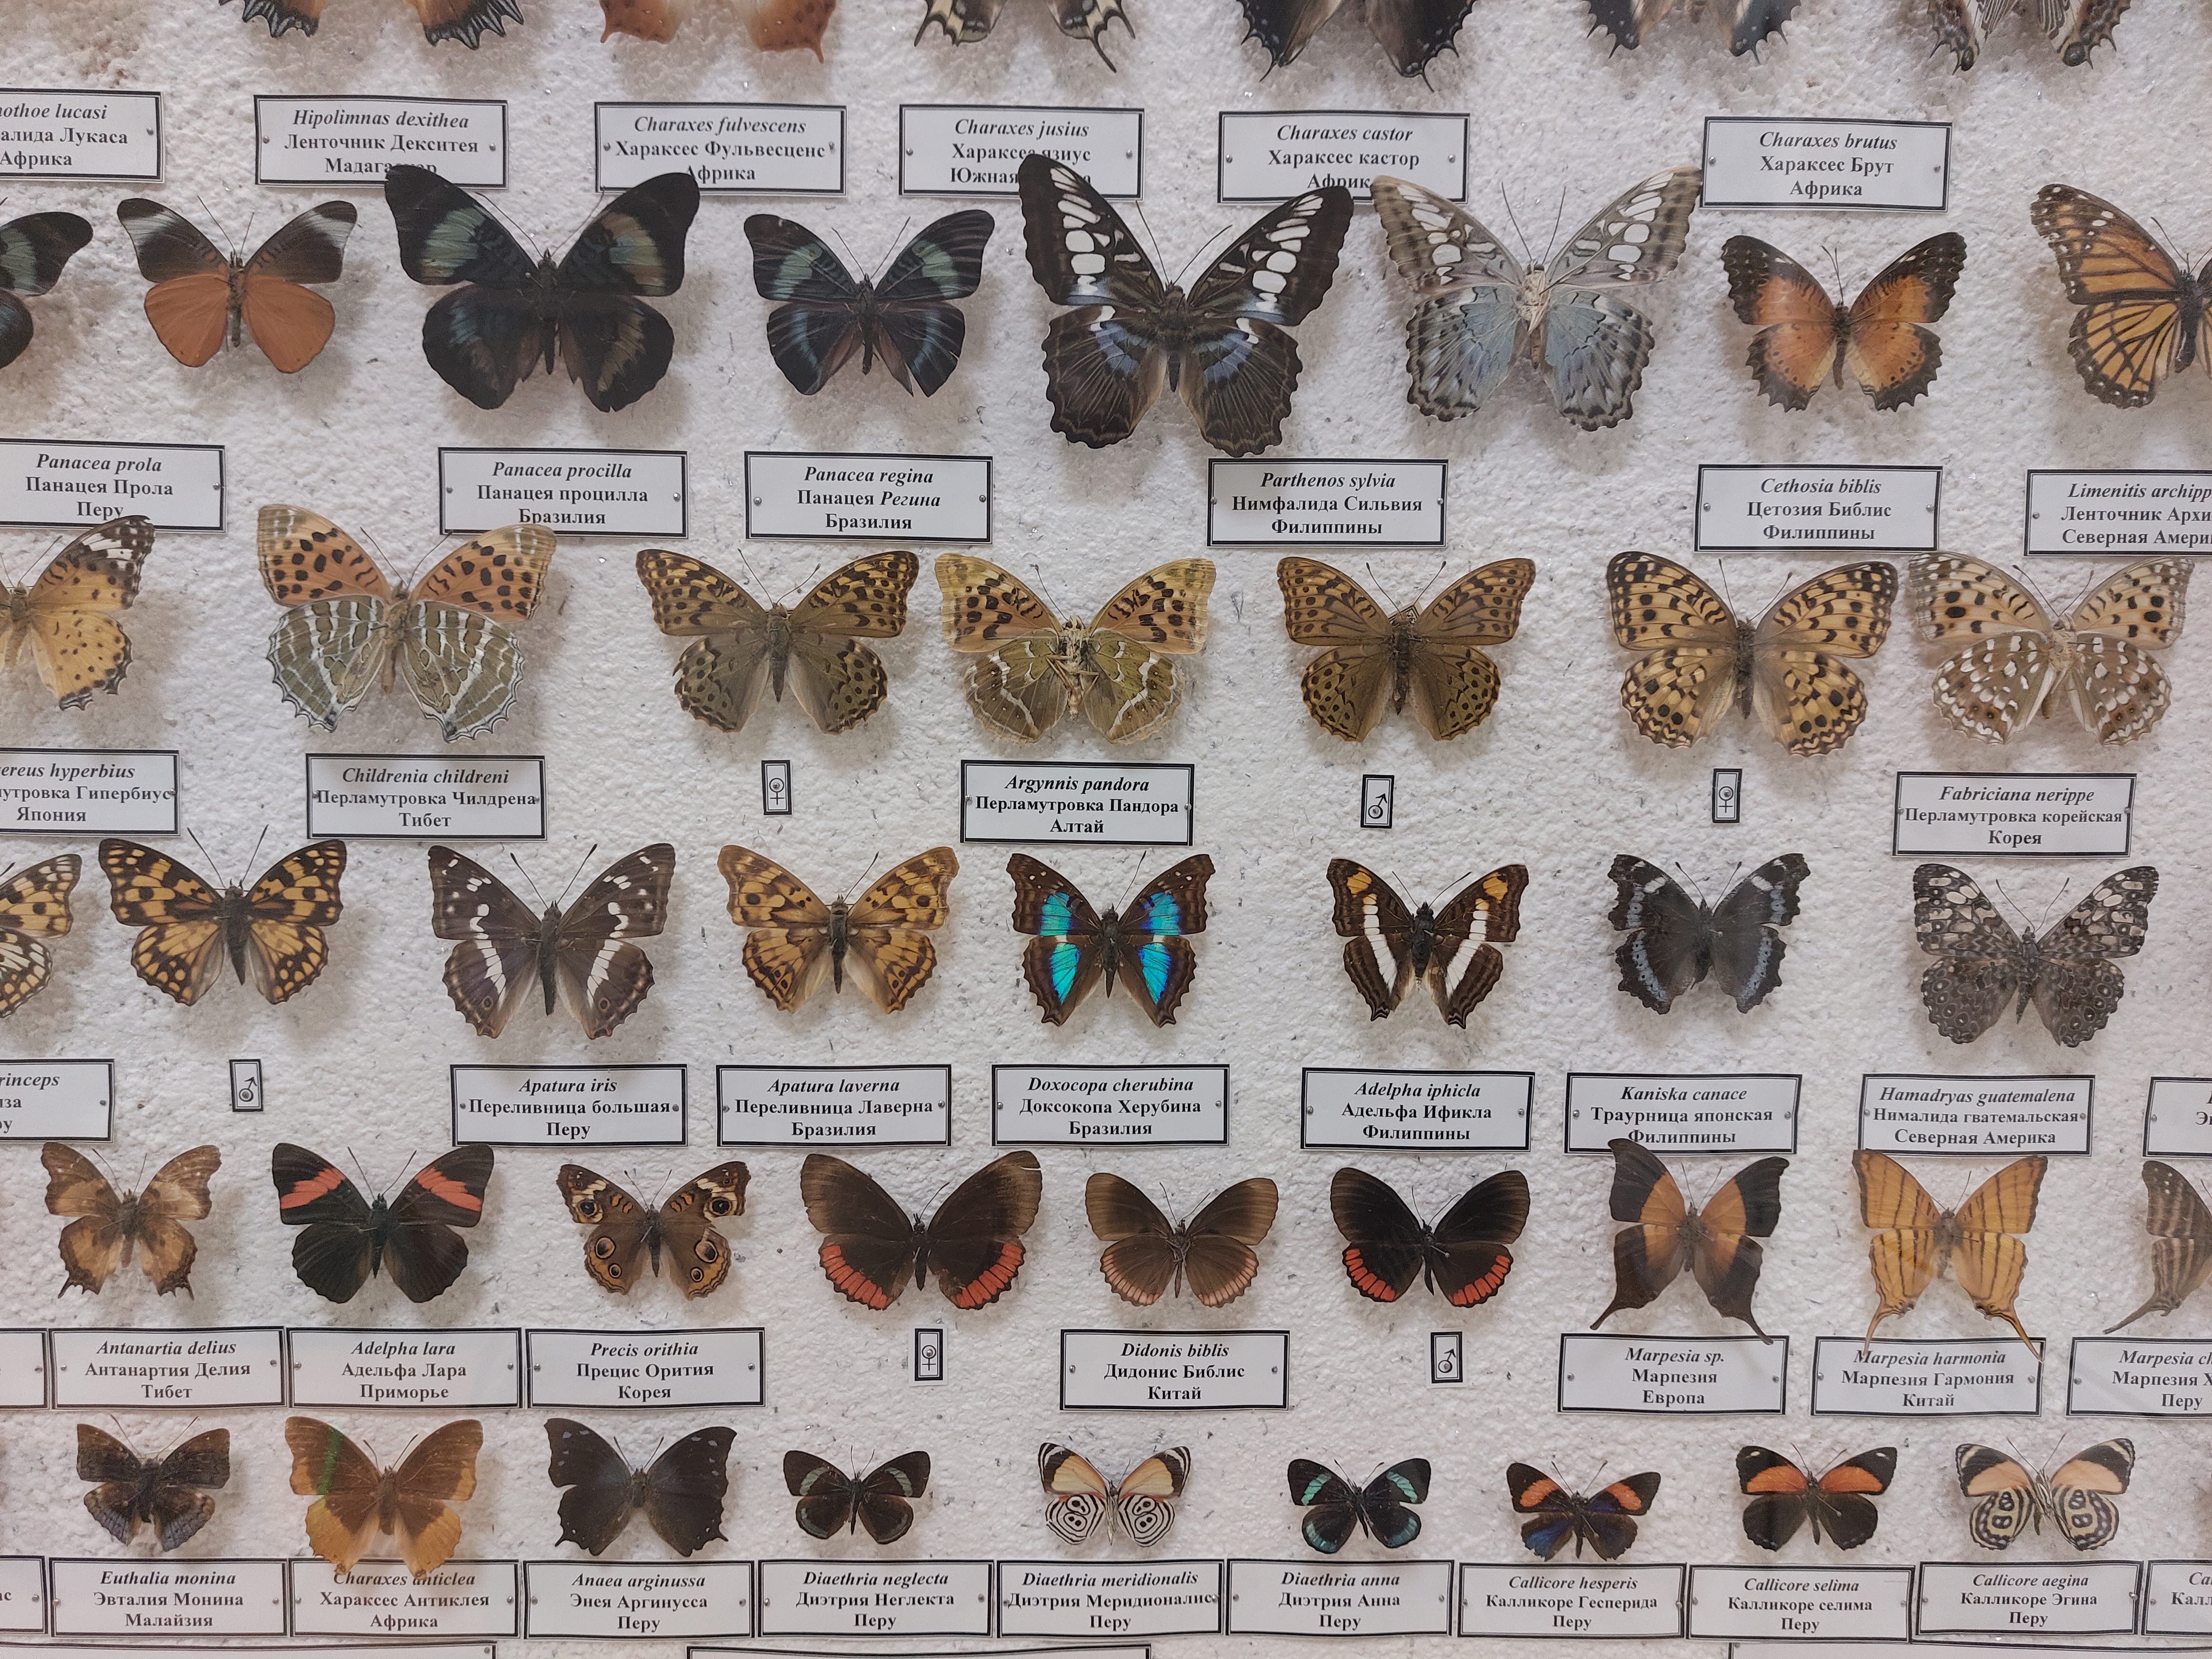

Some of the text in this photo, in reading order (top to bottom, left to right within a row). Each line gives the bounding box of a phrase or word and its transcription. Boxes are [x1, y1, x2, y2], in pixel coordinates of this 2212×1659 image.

[55, 103, 108, 120] lucasi
[292, 109, 469, 130] Hipolimnas dexithea
[634, 116, 807, 137] Charaxes fulvescens
[1276, 124, 1414, 142] Charaxes castor
[58, 127, 129, 147] Лукаса
[284, 133, 478, 153] Ленточник Декситея
[1759, 131, 1898, 150] Charaxes brutus
[0, 150, 73, 170] Африка
[615, 140, 826, 161] Хараксес Фульвесценс
[1268, 149, 1420, 171] Хараксес кастор
[1759, 155, 1894, 177] Хараксес Брут
[1789, 180, 1863, 200] Африка
[35, 453, 162, 476] Panacea prola
[491, 461, 632, 482] Panacea procilla
[803, 466, 934, 487] Panacea regina
[1260, 472, 1396, 492] Parthenos sylvia
[1760, 477, 1882, 494] Cethosia biblis
[25, 476, 174, 499] Панацея Прола
[476, 484, 649, 505] Панацея процилла
[797, 489, 941, 507] Панацея Регина
[1231, 495, 1423, 515] Нимфалида Сильвия
[76, 501, 124, 520] Перу
[518, 508, 607, 525] Бразилия
[1746, 501, 1892, 520] Цетозия Библис
[825, 512, 912, 532] Бразилия
[1271, 519, 1382, 534] Филиппины
[1762, 524, 1875, 540] Филиппины
[49, 762, 136, 782] hyperbius
[342, 767, 510, 784] Childrenia childreni
[1004, 774, 1150, 795] Argynnis pandora
[76, 785, 173, 804] Гипербиус
[316, 789, 537, 809] Перламутровка Чилдрена
[1938, 785, 2095, 806] Fabriciana nerippe
[16, 806, 87, 822] Япония
[974, 796, 1180, 816] Перламутровка Пандора
[398, 812, 452, 828] Тибет
[1049, 817, 1105, 835] Алтай
[1904, 807, 2123, 827] Перламутровка корейская
[1987, 830, 2042, 849] Корея
[518, 1077, 618, 1096] Apatura iris
[766, 1078, 900, 1097] Apatura laverna
[1027, 1076, 1194, 1096] Doxocopa cherubina
[1353, 1081, 1481, 1102] Adelpha iphicla
[1619, 1086, 1747, 1101] Kaniska canace
[1879, 1086, 2076, 1107] Hamadryas guatemalena
[468, 1098, 671, 1117] Переливница большая
[734, 1098, 933, 1118] Переливница Лаверна
[1018, 1098, 1202, 1117] Доксокопа Херубина
[1341, 1102, 1492, 1123] Адельфа Ификла
[1590, 1106, 1773, 1126] Траурница японская
[1873, 1107, 2079, 1125] Нималида гватемальская
[545, 1121, 591, 1140] Перу
[791, 1121, 876, 1140] Бразилия
[1068, 1120, 1152, 1139] Бразилия
[1362, 1124, 1471, 1140] Филиппины
[1627, 1128, 1736, 1144] Филиппины
[1894, 1128, 2056, 1149] Северная Америка
[95, 1340, 237, 1356] Antanartia delius
[350, 1340, 456, 1360] Adelpha lara
[590, 1341, 699, 1357] Precis orithia
[1120, 1342, 1230, 1358] Didonis biblis
[1624, 1347, 1725, 1367] Marpesia sp.
[1853, 1349, 2007, 1368] Marpesia harmonia
[84, 1362, 251, 1381] Антанартия Делия
[341, 1362, 467, 1382] Адельфа Лара
[576, 1362, 714, 1382] Прецис Орития
[1103, 1363, 1245, 1381] Дидонис Библис
[1632, 1368, 1718, 1387] Марпезия
[1841, 1370, 2014, 1390] Марпезия Гармония
[141, 1384, 193, 1399] Тибет
[360, 1383, 449, 1403] Приморье
[618, 1385, 672, 1403] Корея
[1147, 1385, 1202, 1400] Китай
[1642, 1389, 1705, 1408] Европа
[1902, 1393, 1955, 1407] Китай
[100, 1571, 236, 1585] Euthalia monina
[571, 1572, 706, 1592] Anaea arginussa
[802, 1571, 949, 1590] Diaethria neglecta
[1281, 1571, 1400, 1587] Diaethria anna
[1744, 1577, 1860, 1592] Callicore selima
[93, 1591, 244, 1606] Эвталия Монина
[320, 1591, 489, 1610] Хараксес Антиклея
[569, 1593, 708, 1613] Энея Аргинусса
[795, 1591, 955, 1610] Диэтрия Неглекта
[1278, 1592, 1401, 1611] Диэтрия Анна
[1728, 1596, 1873, 1615] Калликоре селима
[125, 1613, 213, 1627] Малайзия
[370, 1614, 439, 1632] Африка
[617, 1615, 661, 1634] Перу
[854, 1613, 897, 1631] Перу
[1319, 1614, 1361, 1632] Перу
[1781, 1617, 1820, 1634] Перу
